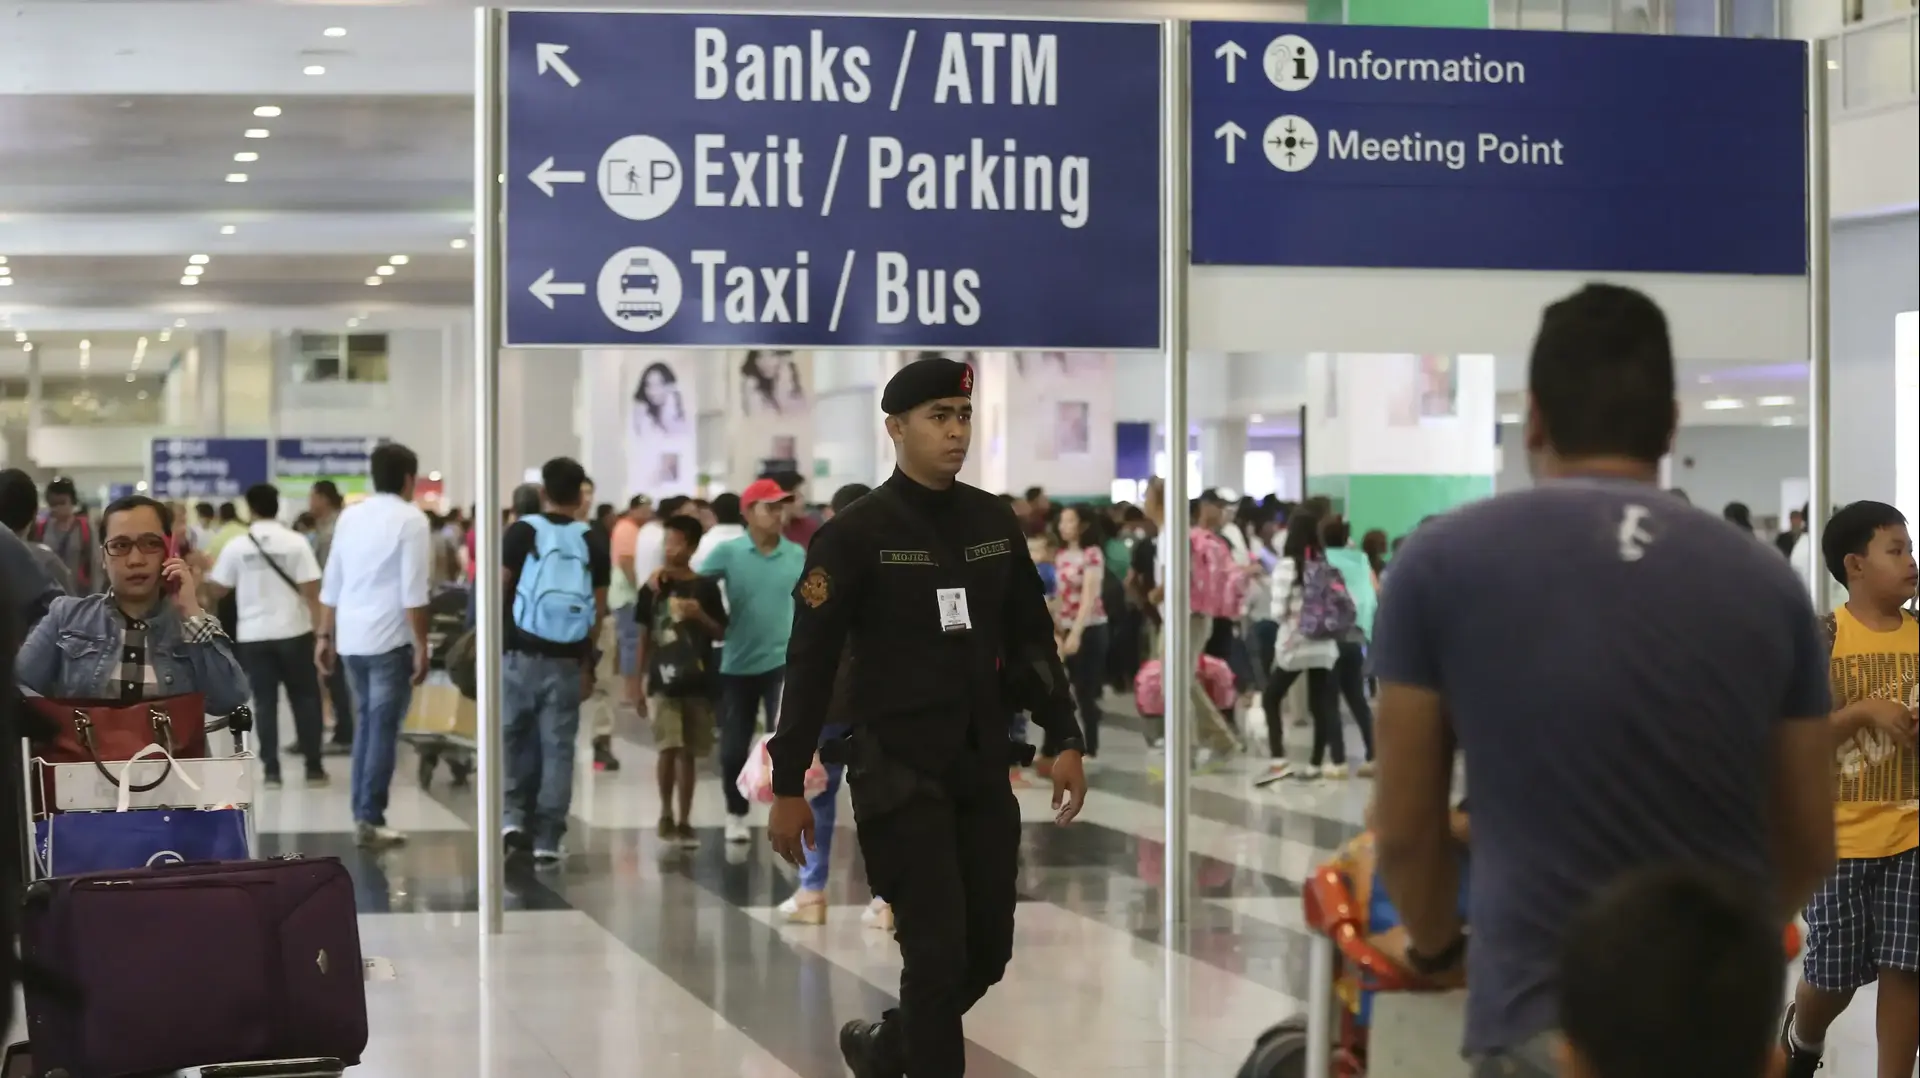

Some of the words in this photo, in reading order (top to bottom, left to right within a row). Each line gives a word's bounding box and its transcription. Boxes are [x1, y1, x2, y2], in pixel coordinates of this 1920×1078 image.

[695, 27, 872, 103] Banks
[890, 30, 917, 111] /
[934, 32, 1057, 105] ATM
[1328, 49, 1525, 84] Information
[1328, 130, 1465, 170] Meeting
[1478, 134, 1563, 166] Point
[694, 134, 803, 208] Exit
[821, 134, 848, 216] /
[868, 136, 1089, 228] Parking
[691, 250, 809, 325] Taxi
[829, 250, 856, 332] /
[876, 252, 981, 326] Bus
[891, 553, 930, 562] MOJICA
[974, 543, 1005, 557] POLICE
